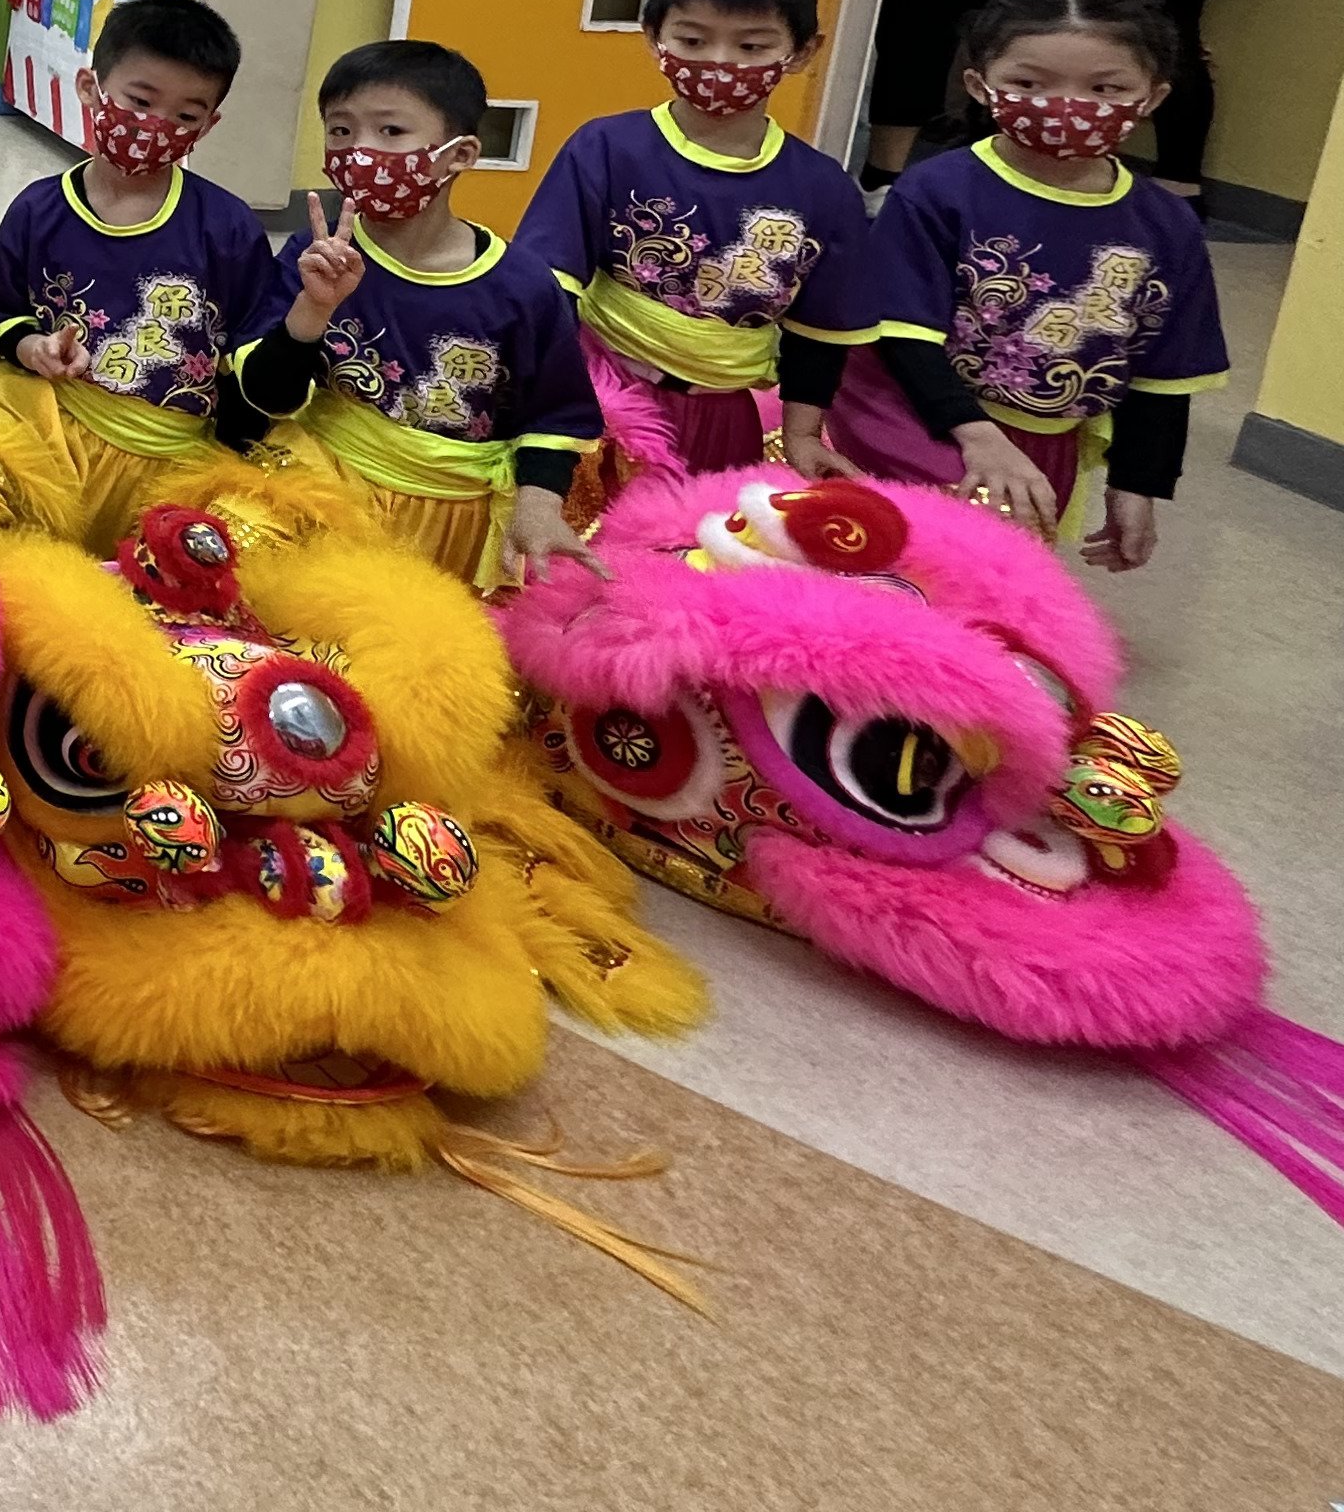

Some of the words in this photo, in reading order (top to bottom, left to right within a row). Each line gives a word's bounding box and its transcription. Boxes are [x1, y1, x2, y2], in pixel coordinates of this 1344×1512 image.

[94, 283, 196, 385] 保良局
[1028, 252, 1144, 348] 保良局
